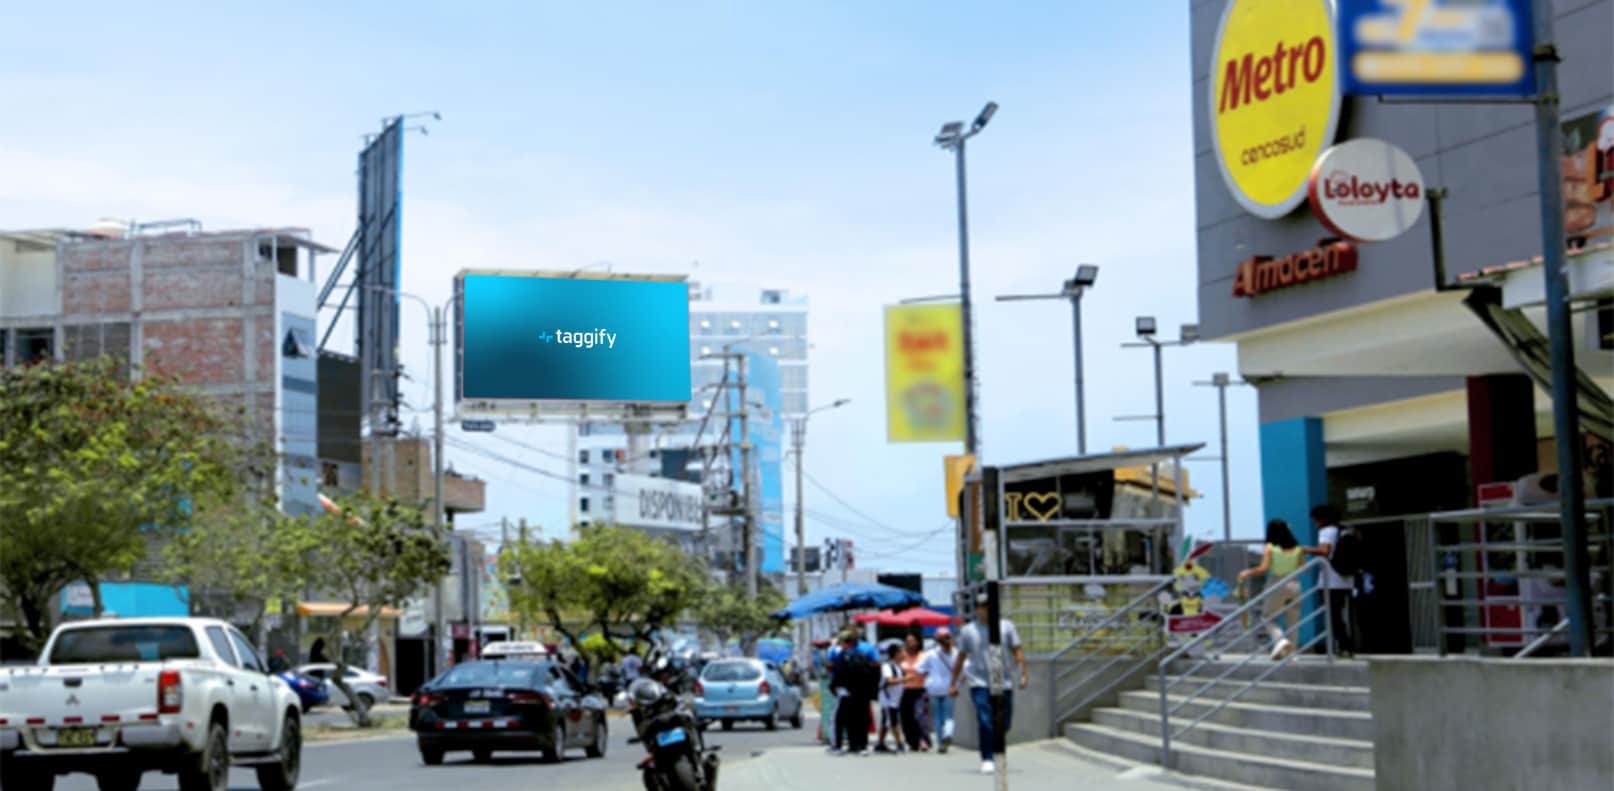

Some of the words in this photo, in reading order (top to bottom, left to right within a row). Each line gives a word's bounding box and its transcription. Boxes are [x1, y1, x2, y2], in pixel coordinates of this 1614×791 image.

[1219, 36, 1325, 114] Metro
[1241, 128, 1306, 165] cencosud
[1324, 175, 1419, 204] Loloyta
[556, 328, 616, 349] taggify
